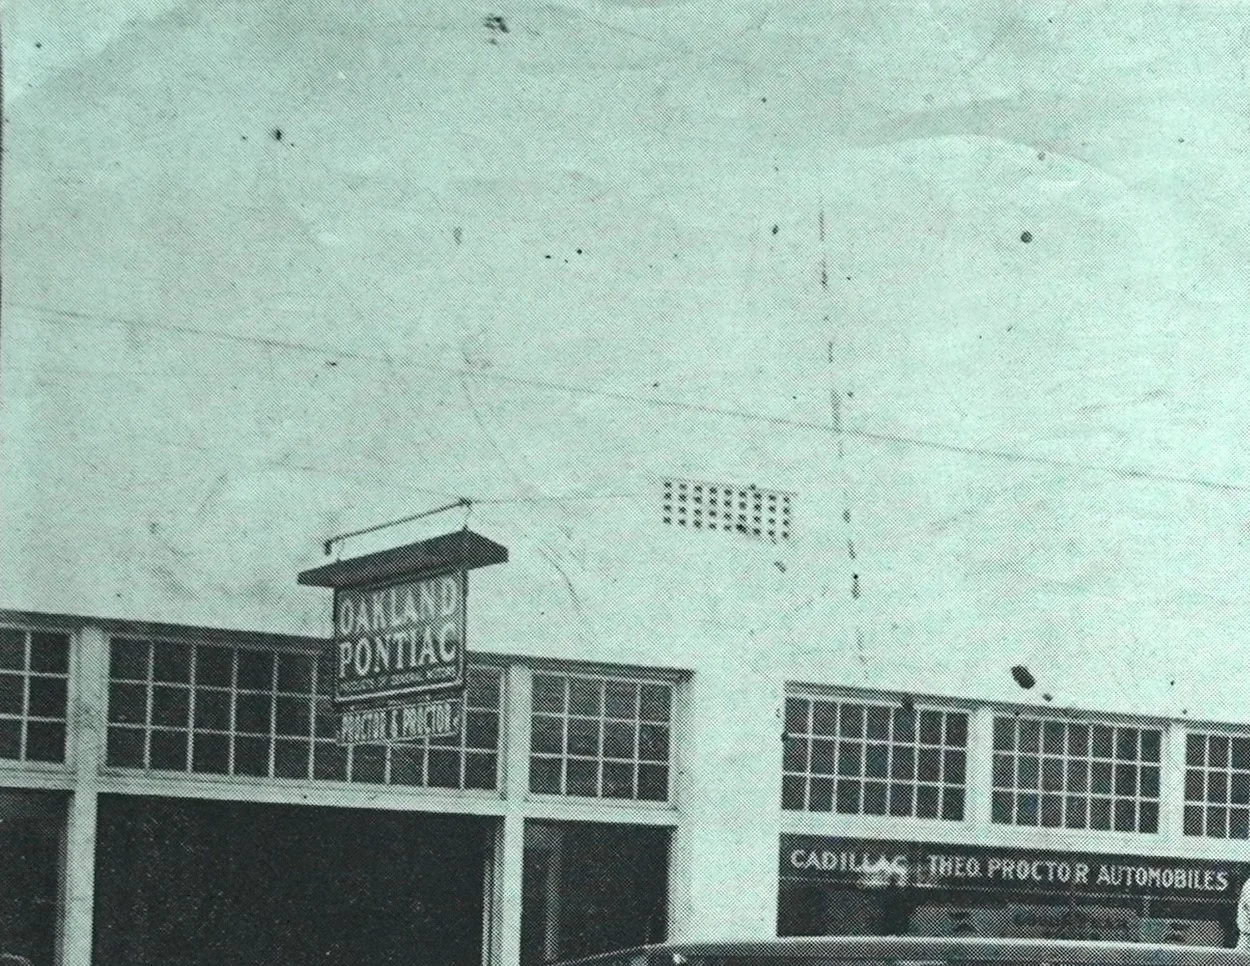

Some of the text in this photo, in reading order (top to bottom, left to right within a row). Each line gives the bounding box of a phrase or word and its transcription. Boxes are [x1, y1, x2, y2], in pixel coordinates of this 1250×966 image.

[339, 577, 457, 635] OAKLAND
[338, 622, 457, 679] PONTIAC
[790, 847, 907, 876] CADILLAC
[987, 856, 1088, 886] PROCTOR
[1097, 863, 1229, 892] AUTOMOBILES
